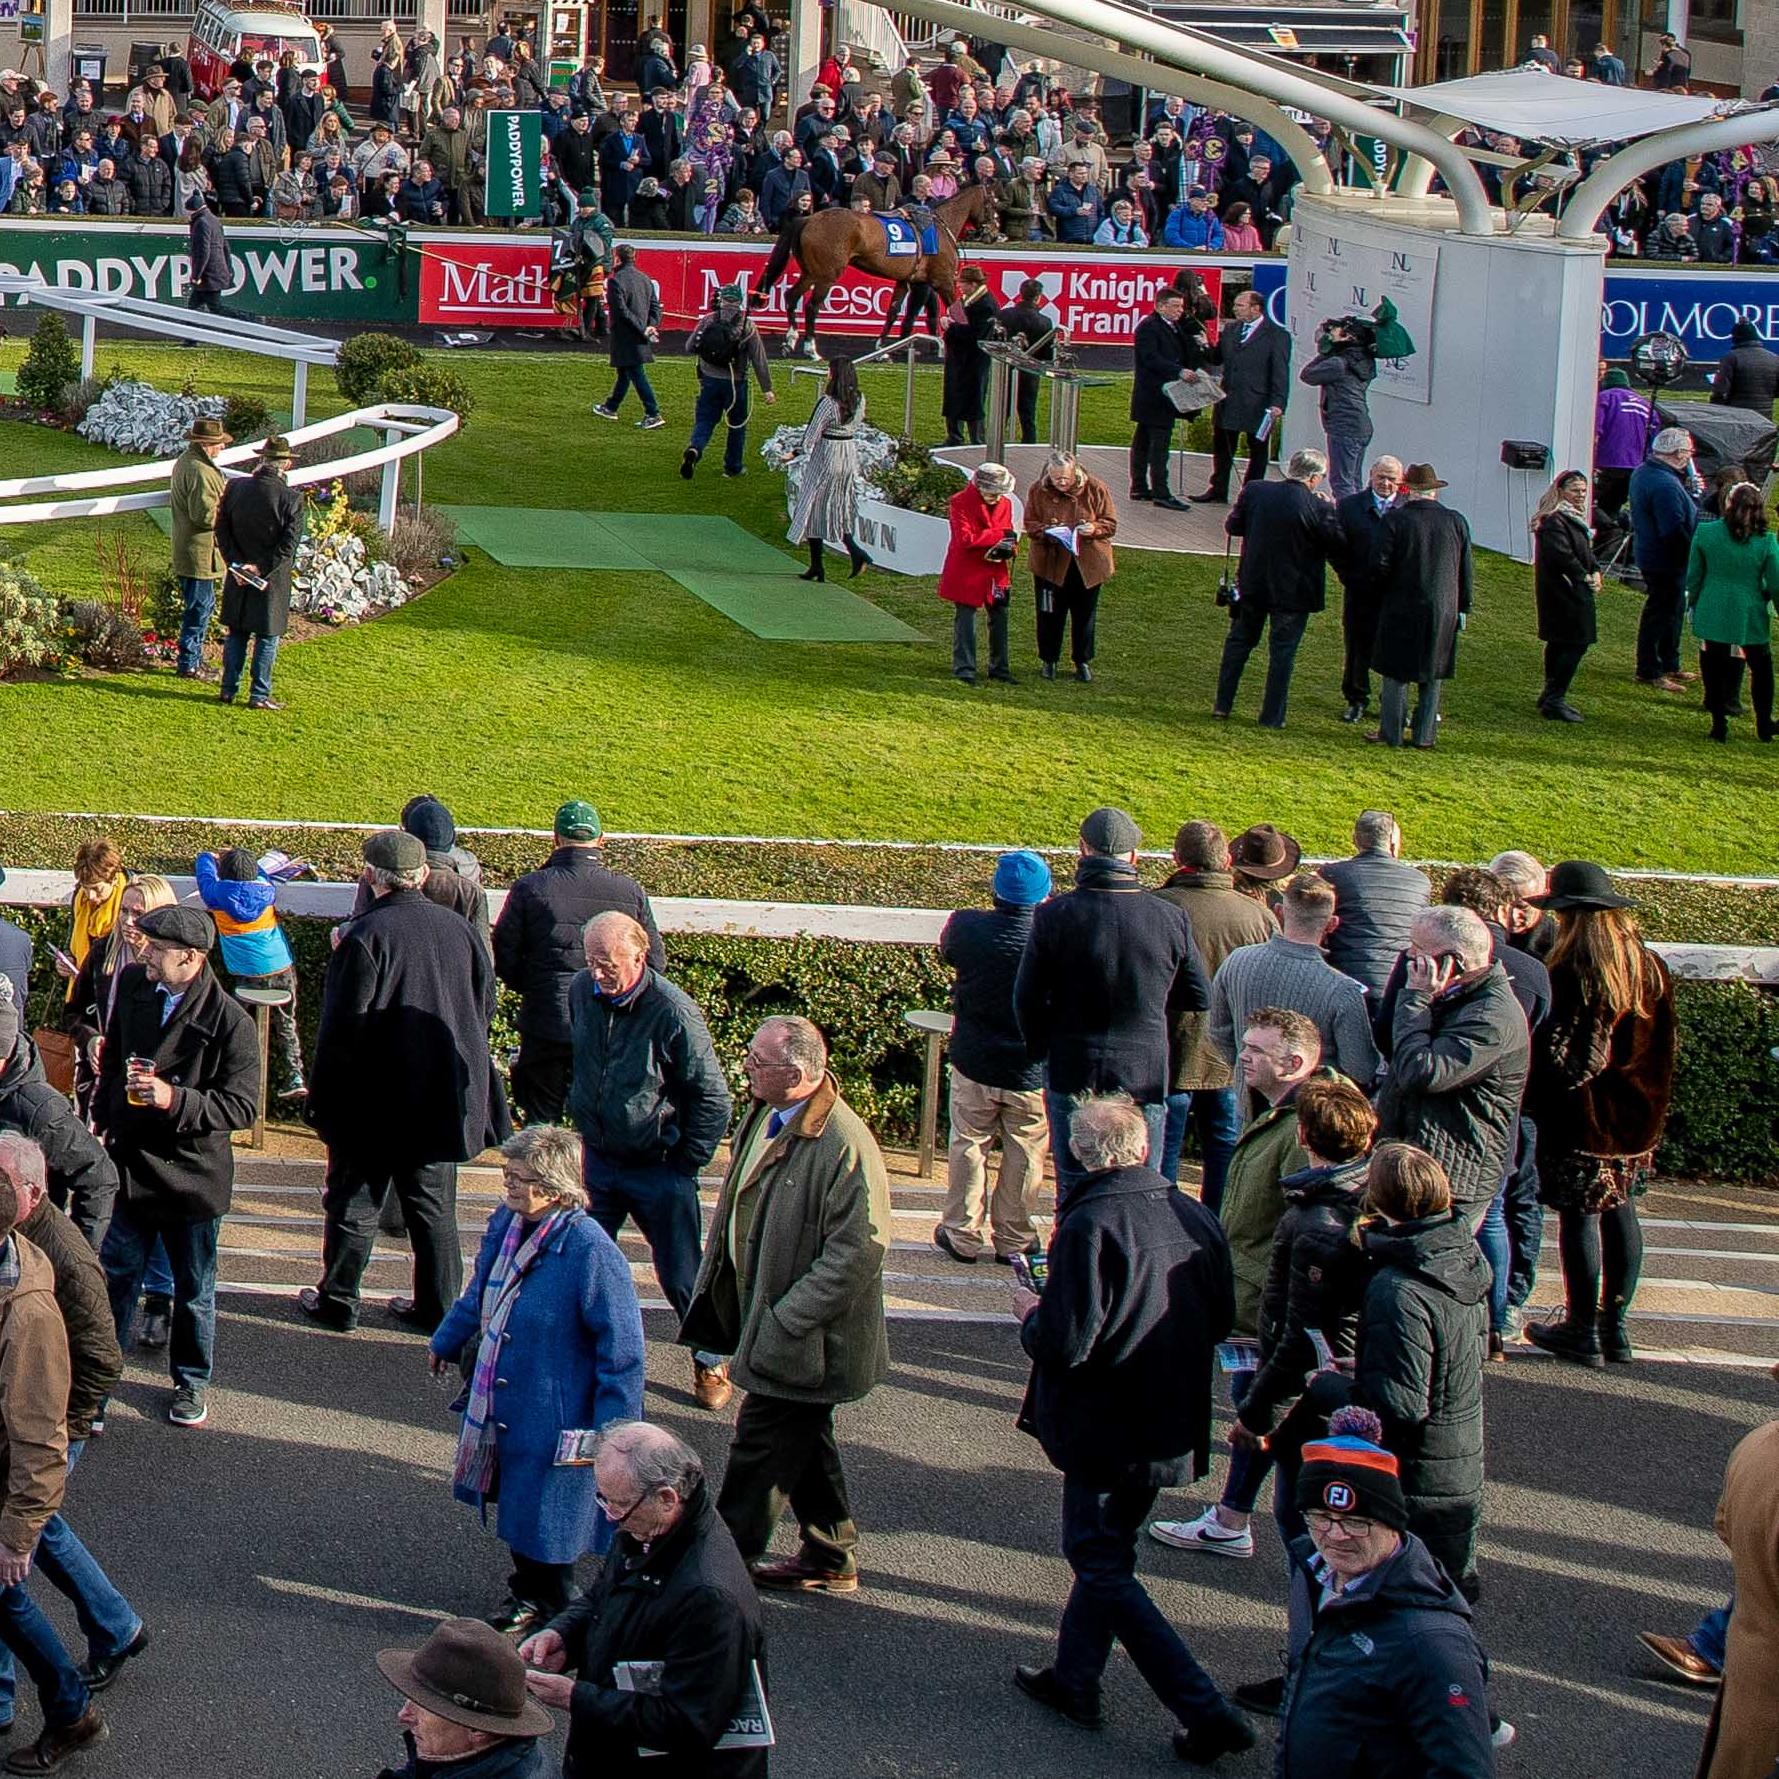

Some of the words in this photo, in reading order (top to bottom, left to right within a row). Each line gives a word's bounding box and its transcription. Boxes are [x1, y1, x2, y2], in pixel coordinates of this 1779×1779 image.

[887, 223, 903, 241] 9
[1069, 272, 1168, 309] Knight
[1600, 300, 1779, 341] OLMORE
[1329, 1486, 1349, 1506] FJ
